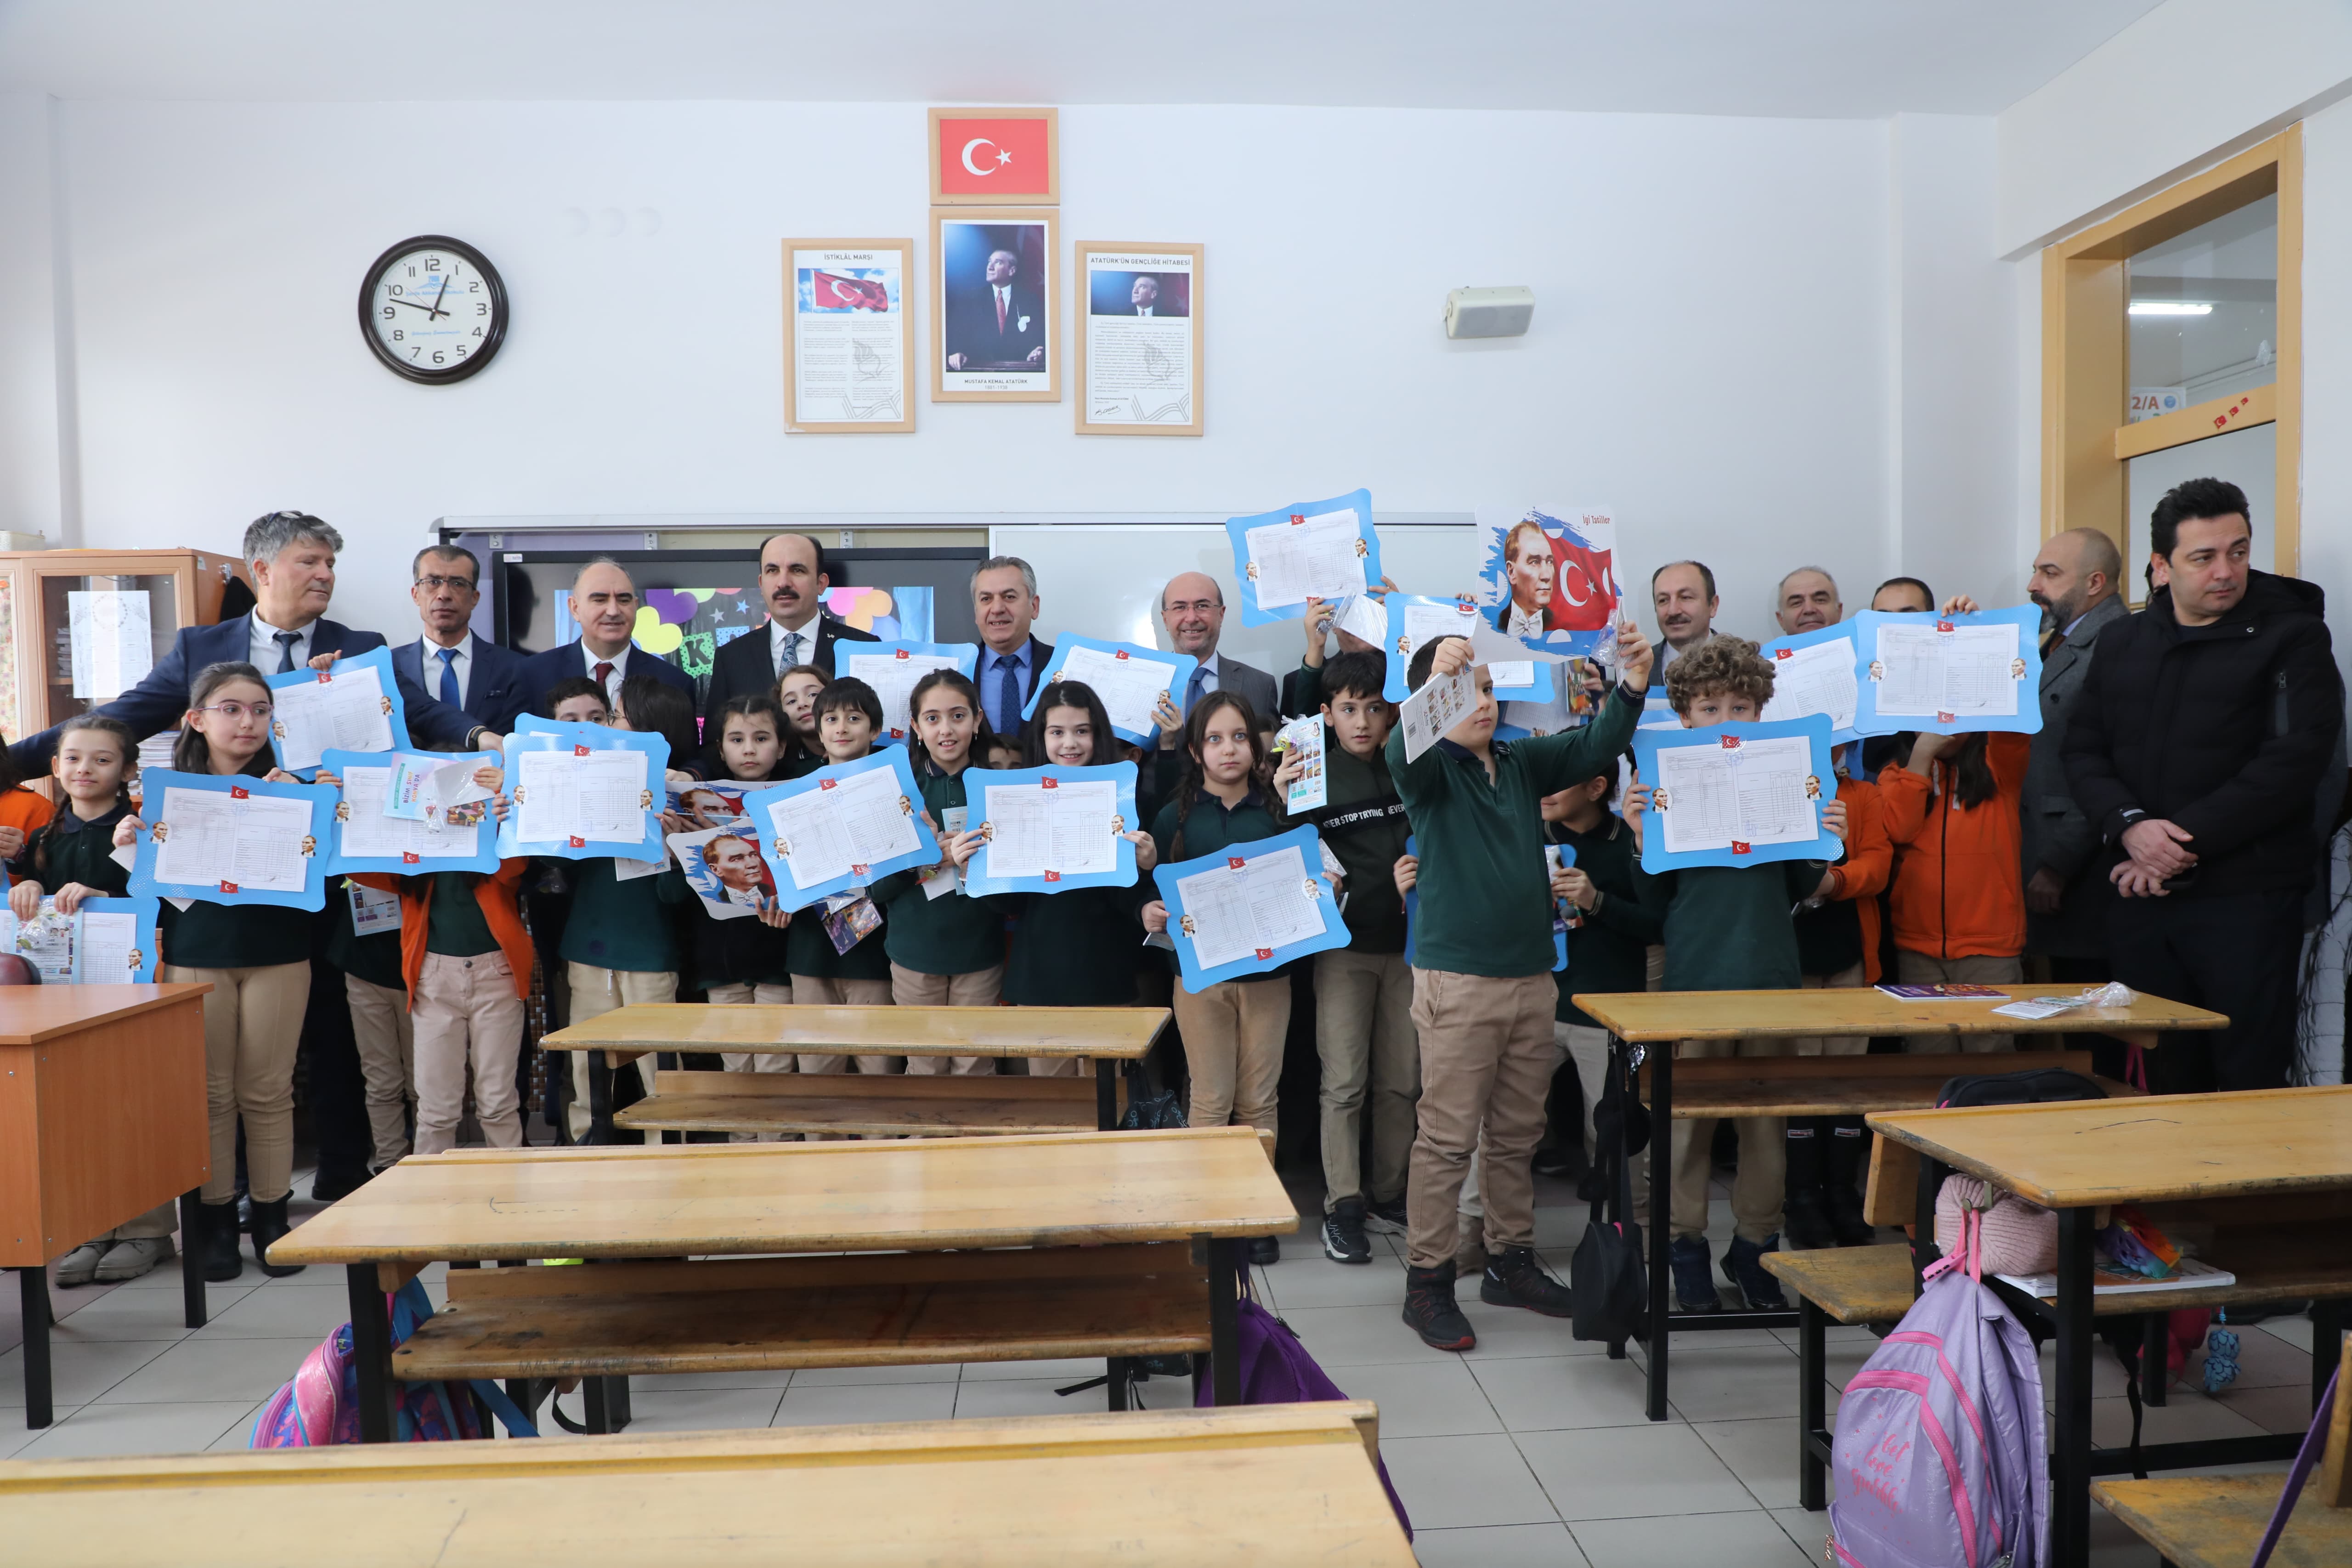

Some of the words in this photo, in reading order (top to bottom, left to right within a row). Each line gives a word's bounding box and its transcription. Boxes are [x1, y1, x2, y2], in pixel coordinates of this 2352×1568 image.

[425, 259, 441, 272] 12
[455, 265, 459, 275] 1
[408, 266, 415, 277] 11
[388, 284, 403, 296] 10
[469, 282, 479, 293] 2
[384, 306, 395, 319] 9
[476, 303, 487, 316] 3
[394, 330, 404, 341] 8
[472, 327, 482, 338] 4
[412, 347, 421, 358] 7
[457, 345, 466, 356] 5
[433, 351, 444, 363] 6
[1582, 514, 1590, 526] İyi
[1592, 515, 1611, 525] Tatiller
[1340, 813, 1358, 824] STOP
[1358, 809, 1384, 820] TRYING
